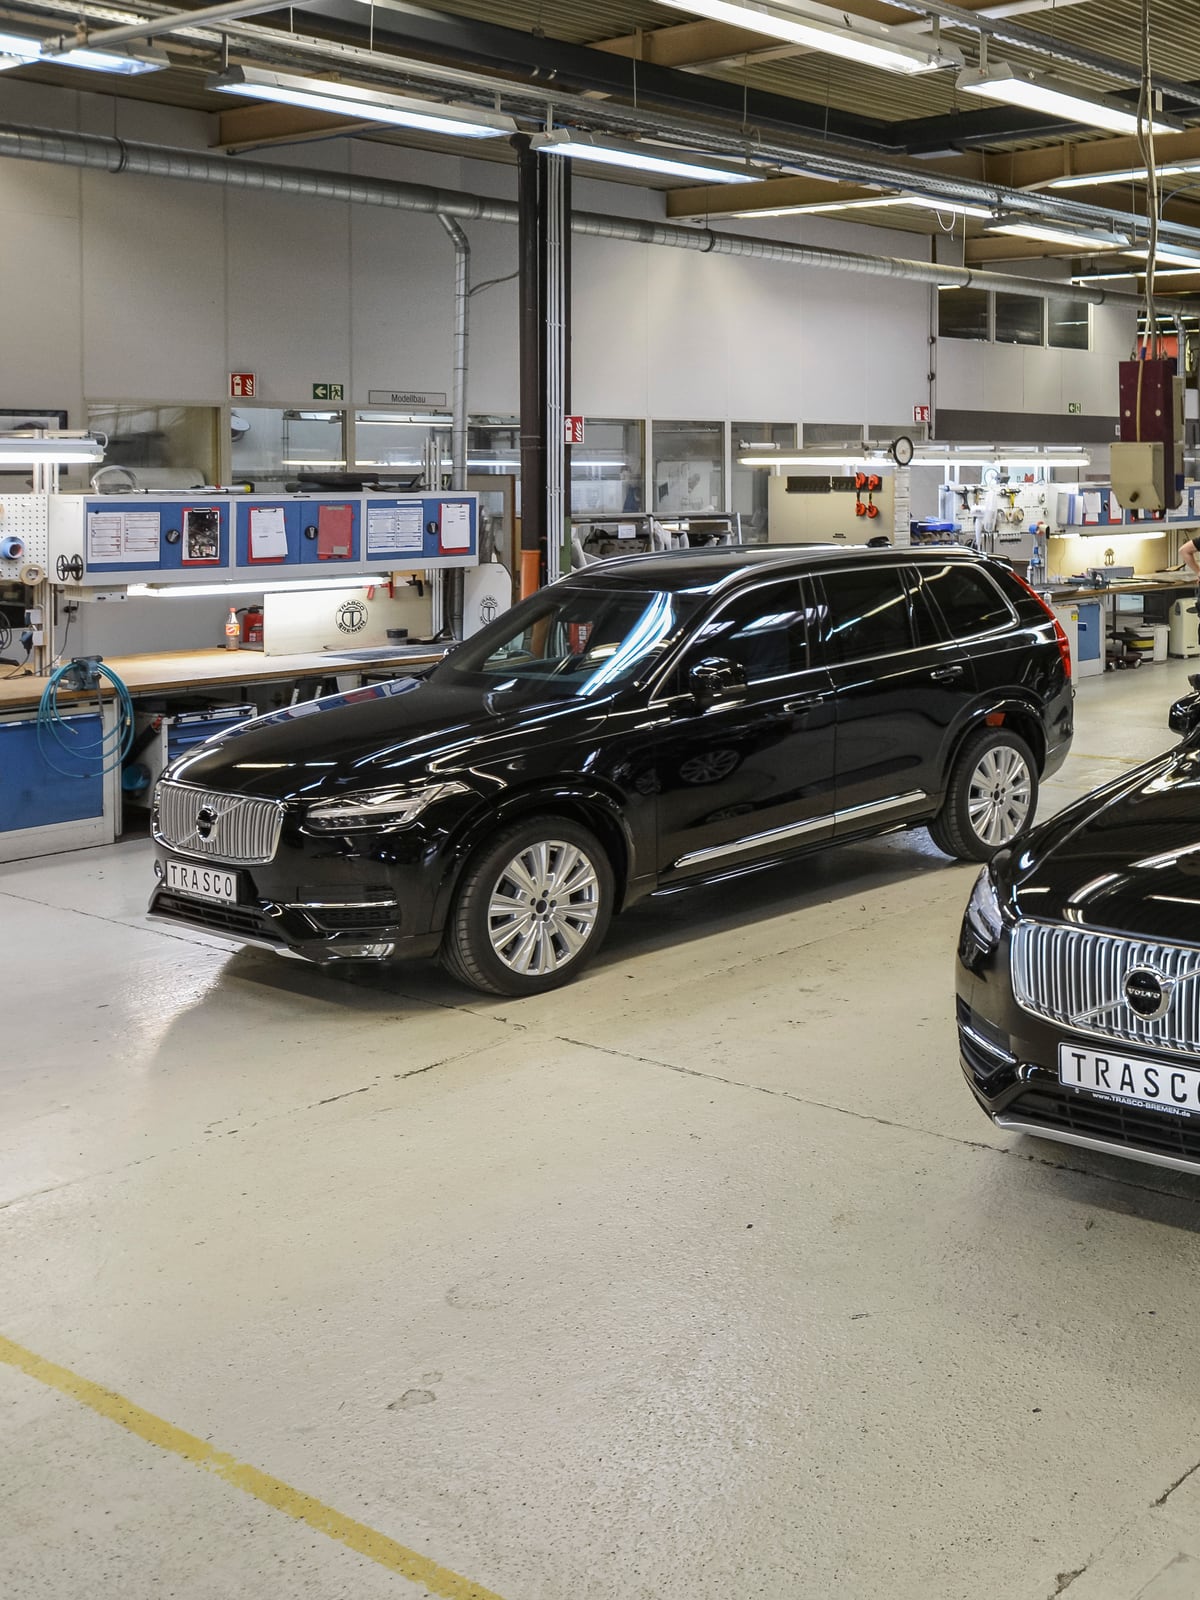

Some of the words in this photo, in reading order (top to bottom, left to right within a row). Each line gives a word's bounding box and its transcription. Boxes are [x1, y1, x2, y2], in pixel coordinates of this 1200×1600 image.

[391, 393, 426, 404] Modellbau
[339, 600, 365, 613] TRASCO
[170, 865, 233, 897] TRASCO
[1127, 987, 1161, 999] VOLVO
[1091, 1092, 1191, 1118] www.TRASCO-BREMEN.de
